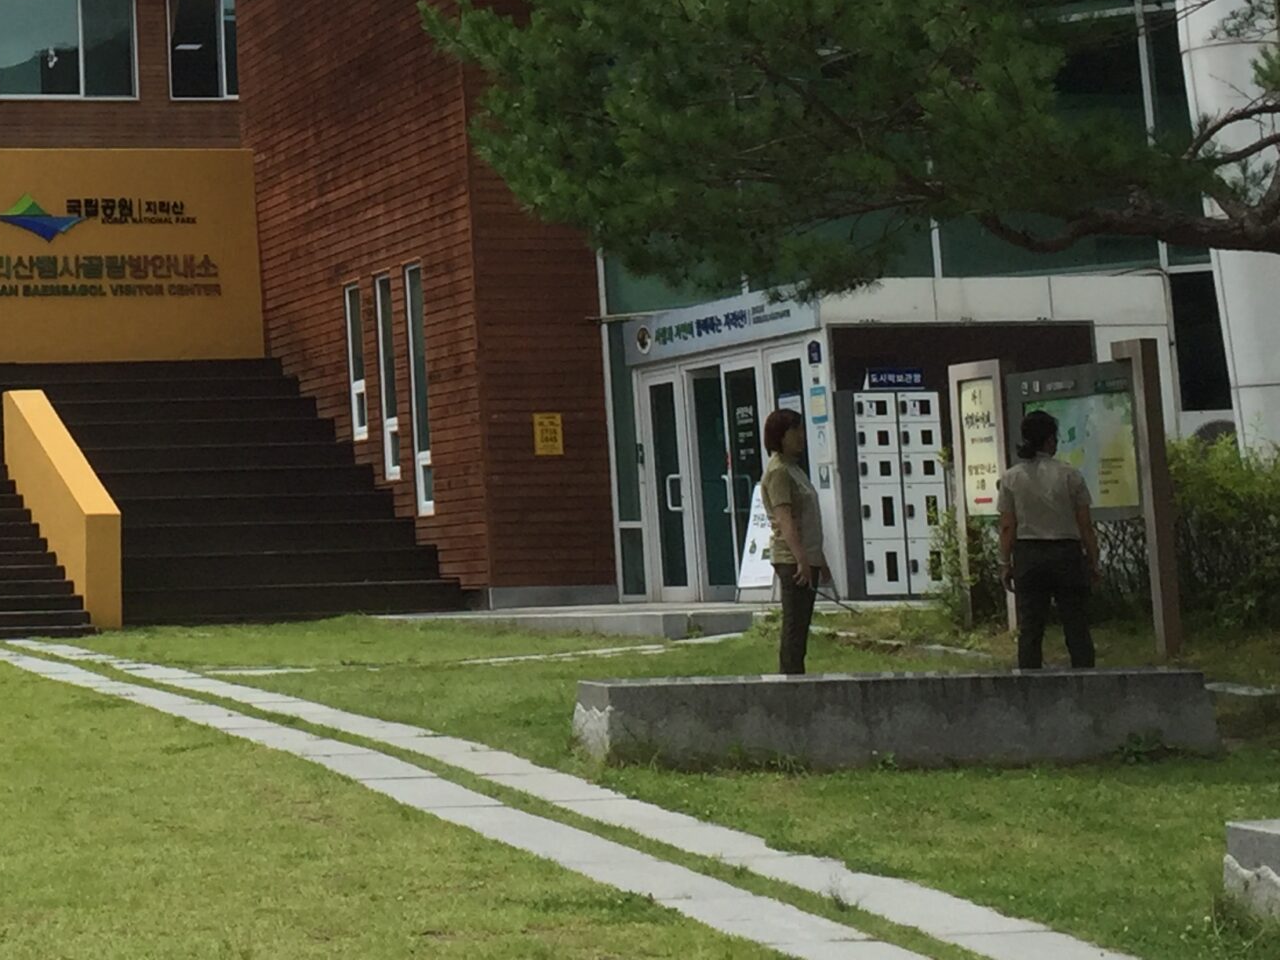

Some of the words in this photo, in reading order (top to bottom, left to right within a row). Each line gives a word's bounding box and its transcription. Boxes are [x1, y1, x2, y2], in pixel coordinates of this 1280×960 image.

[66, 197, 134, 218] 국립공원
[145, 201, 185, 215] 지리산
[131, 216, 173, 224] NATIONAL
[175, 216, 197, 224] PARK
[22, 284, 107, 297] BAEMSAGOL
[110, 284, 164, 297] VISITOR
[167, 283, 222, 297] CENTER
